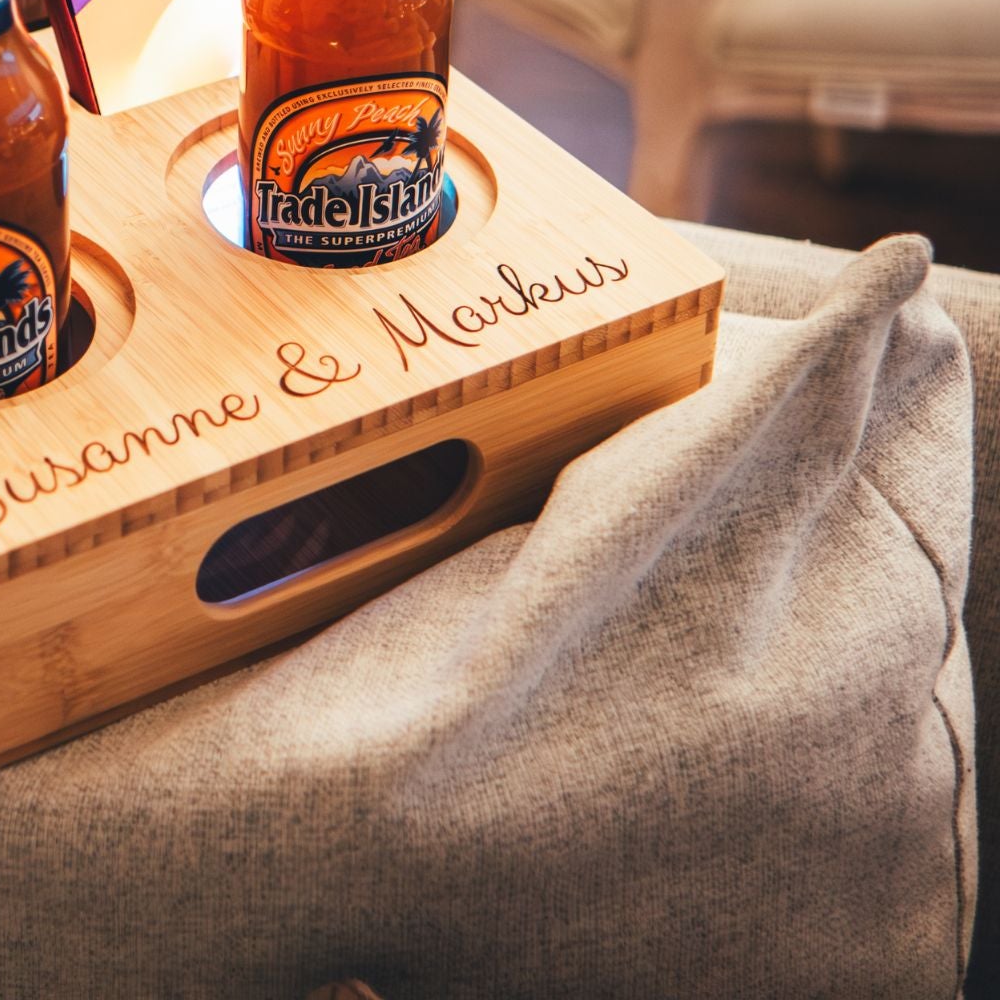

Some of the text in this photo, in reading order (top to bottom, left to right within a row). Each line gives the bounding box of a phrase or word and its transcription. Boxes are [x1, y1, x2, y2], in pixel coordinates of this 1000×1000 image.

[291, 96, 315, 109] USING
[316, 84, 373, 100] EXCLUSIVELY
[376, 81, 414, 90] SELECTED
[277, 96, 430, 175] Sunny Peach
[285, 203, 437, 246] THE SUPERPREMIUM
[276, 342, 361, 397] &
[372, 256, 629, 372] Markus
